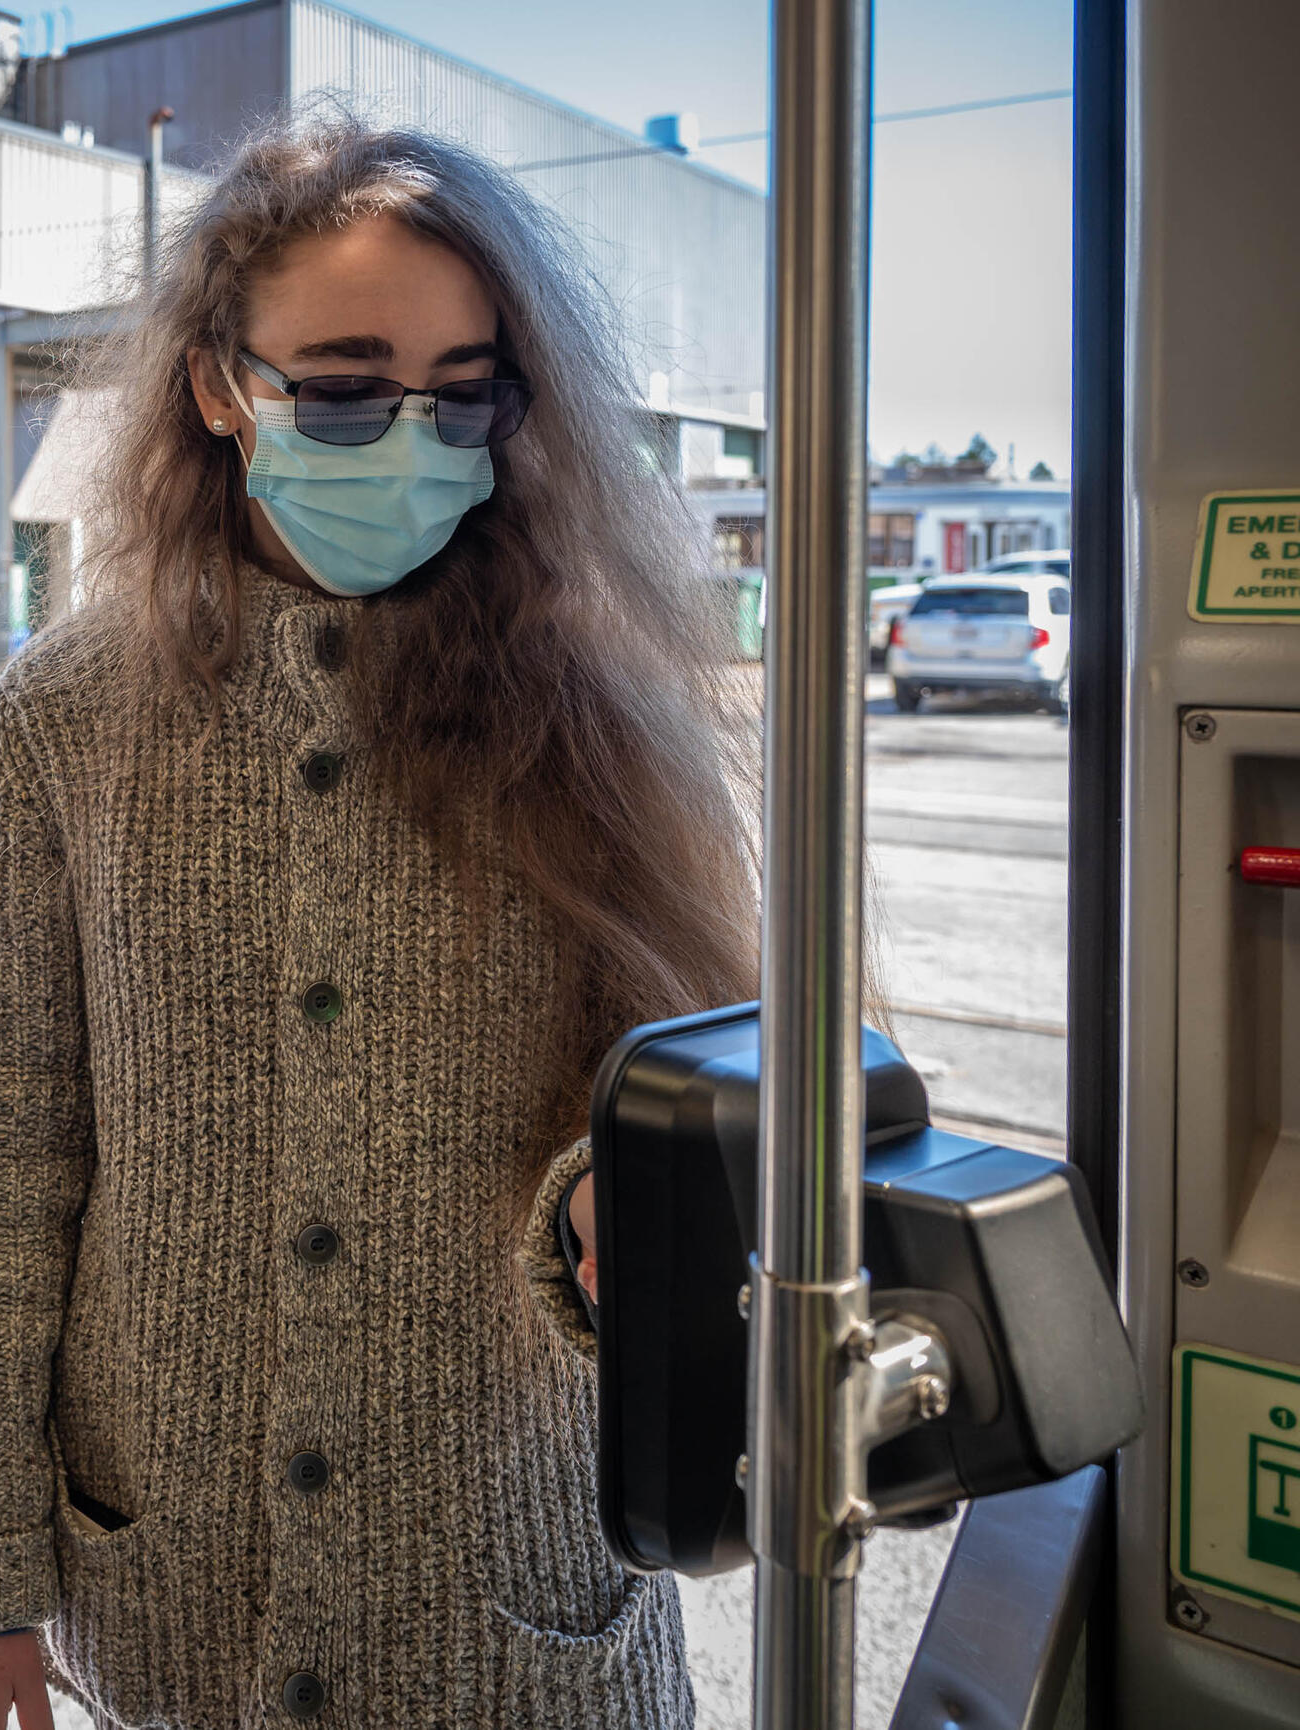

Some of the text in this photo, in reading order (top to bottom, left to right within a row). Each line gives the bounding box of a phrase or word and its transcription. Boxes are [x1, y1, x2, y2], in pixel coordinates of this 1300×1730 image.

[1228, 515, 1300, 534] EME
[1250, 542, 1270, 560] &
[1234, 585, 1300, 598] APERT
